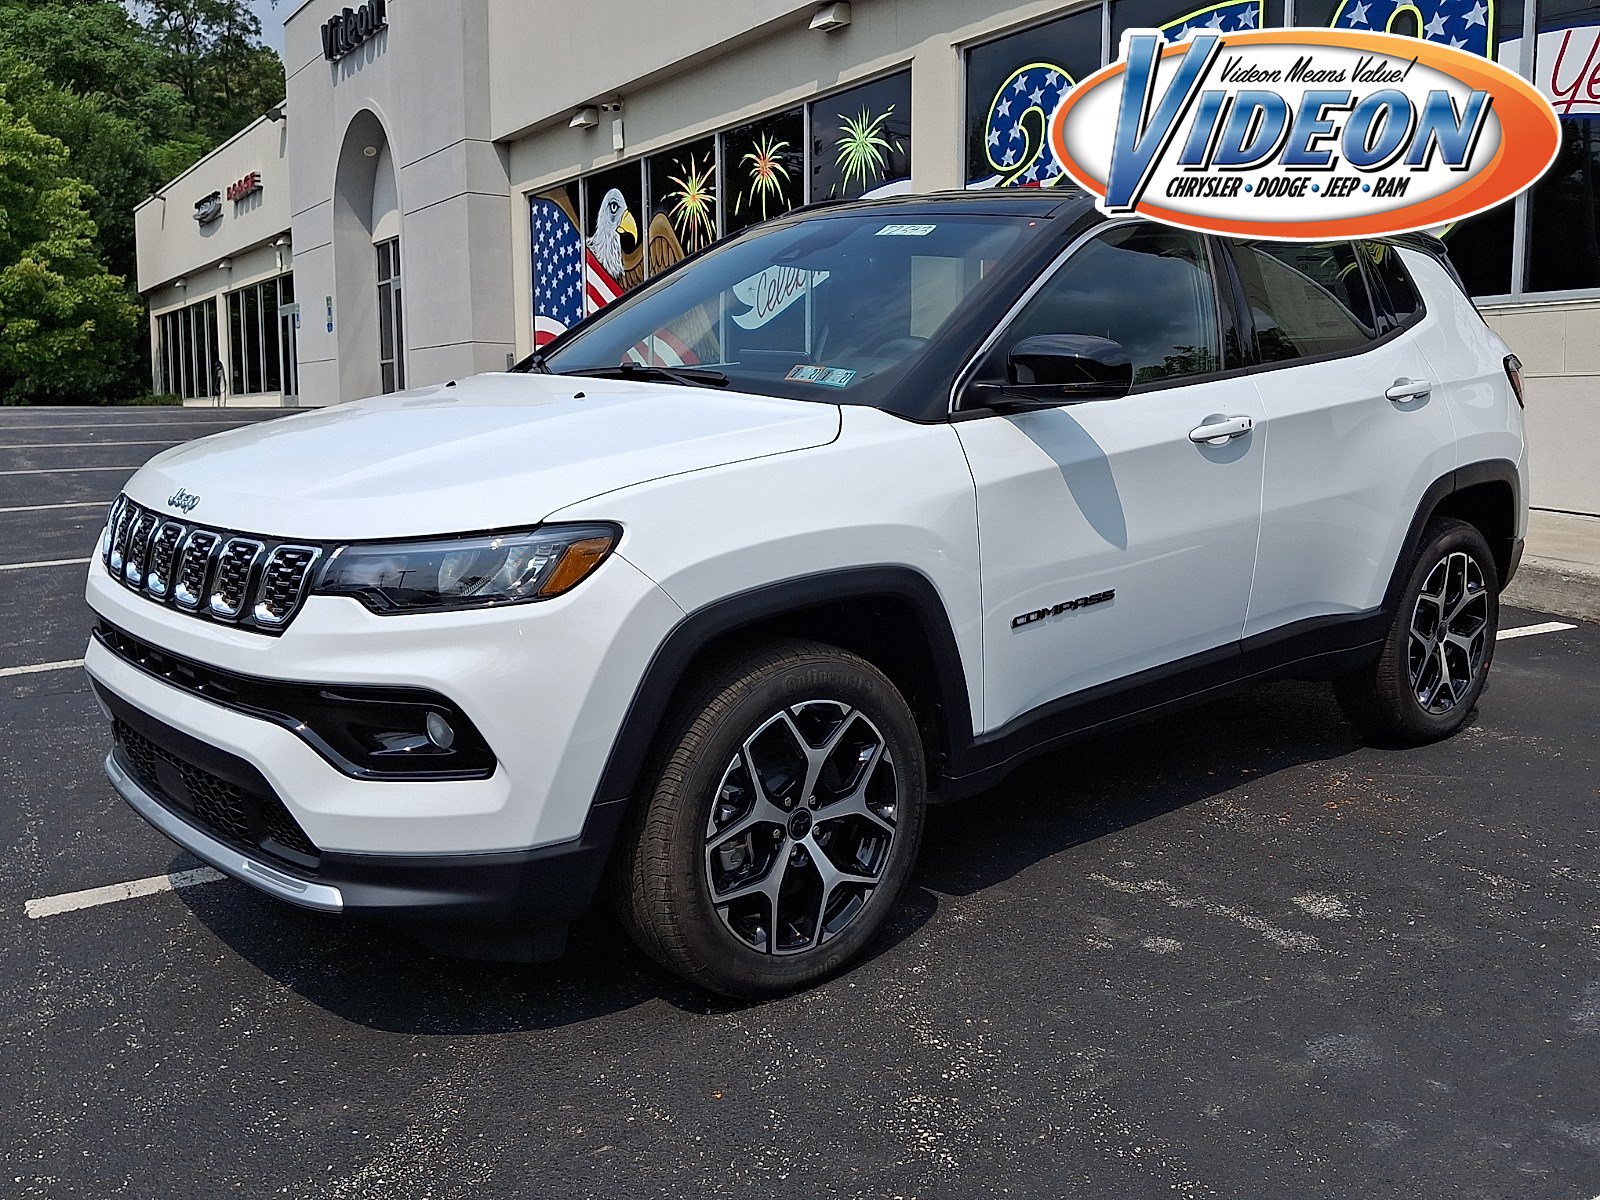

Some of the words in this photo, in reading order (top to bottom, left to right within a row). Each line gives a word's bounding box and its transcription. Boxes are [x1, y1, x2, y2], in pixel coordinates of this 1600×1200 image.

[321, 0, 387, 61] Videon
[168, 488, 200, 514] Jeep
[1010, 589, 1116, 629] COMPASS
